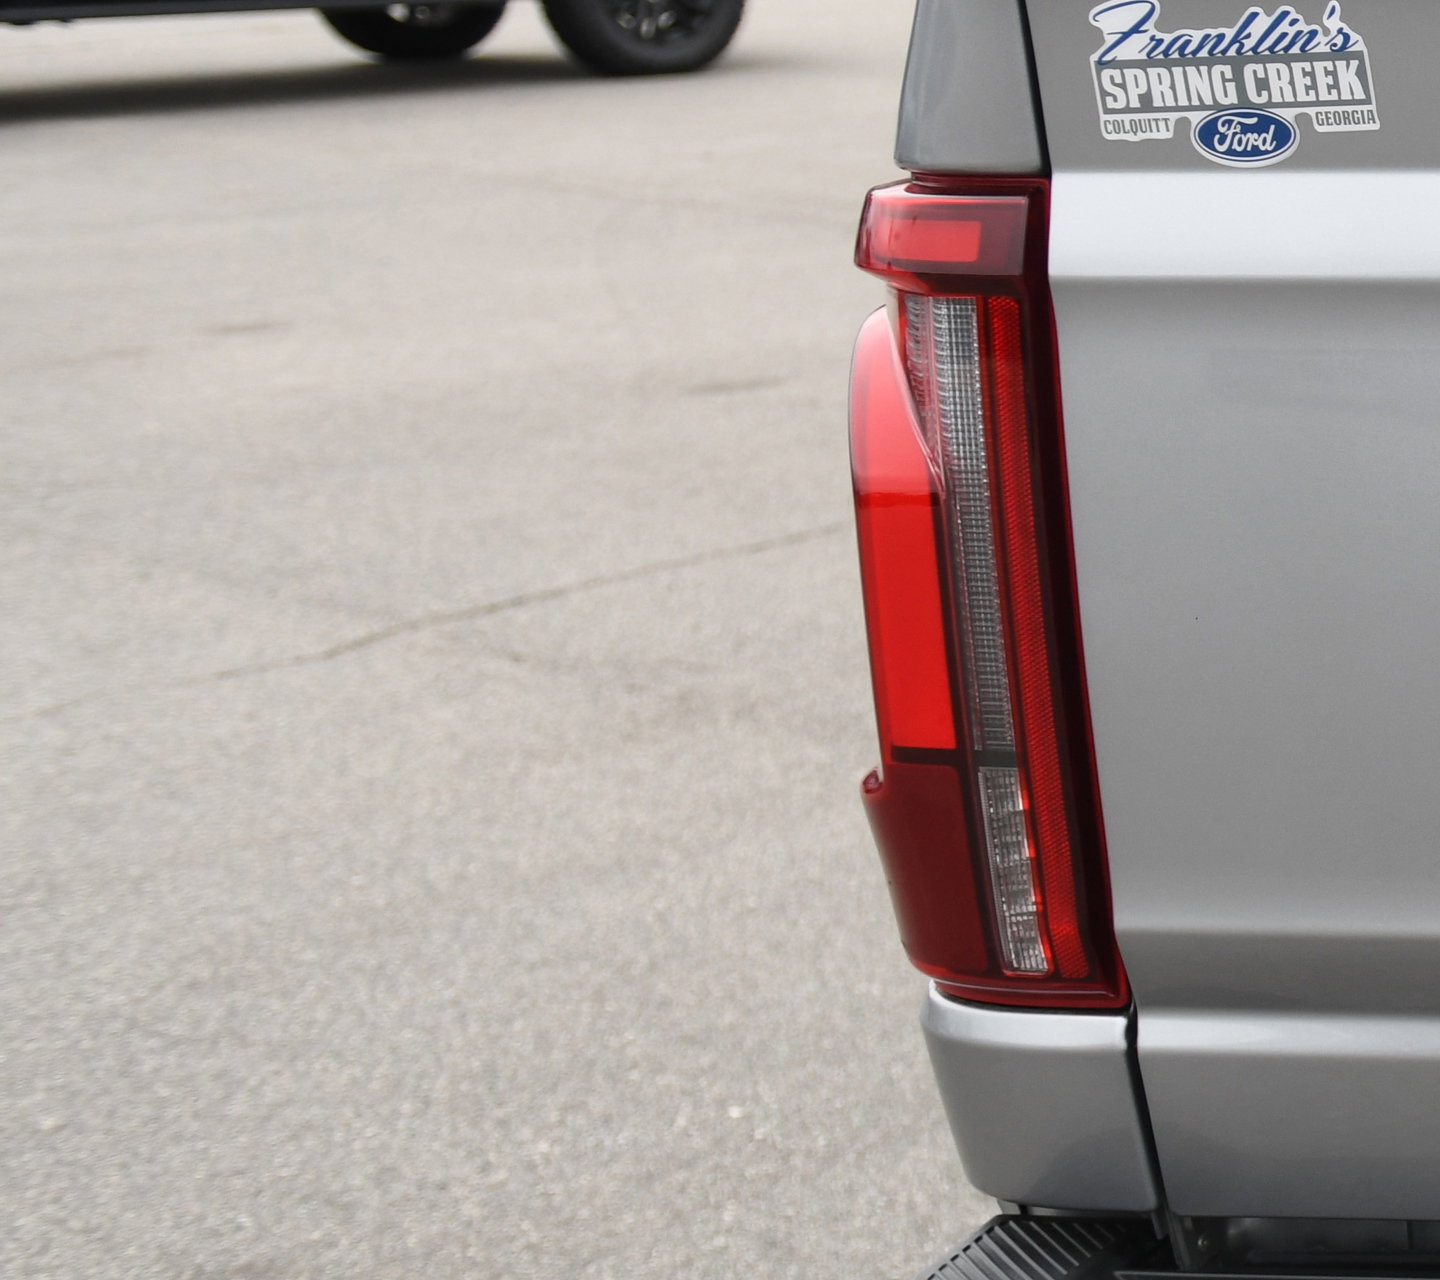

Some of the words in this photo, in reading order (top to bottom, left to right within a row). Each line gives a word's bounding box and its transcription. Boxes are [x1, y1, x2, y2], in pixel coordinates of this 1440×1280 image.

[1093, 0, 1360, 65] Franklin's
[1101, 64, 1237, 109] SPRING
[1244, 59, 1367, 104] CREEK
[1103, 117, 1171, 136] COLQUITT
[1213, 115, 1277, 152] Ford
[1315, 109, 1377, 127] GEORGIA
